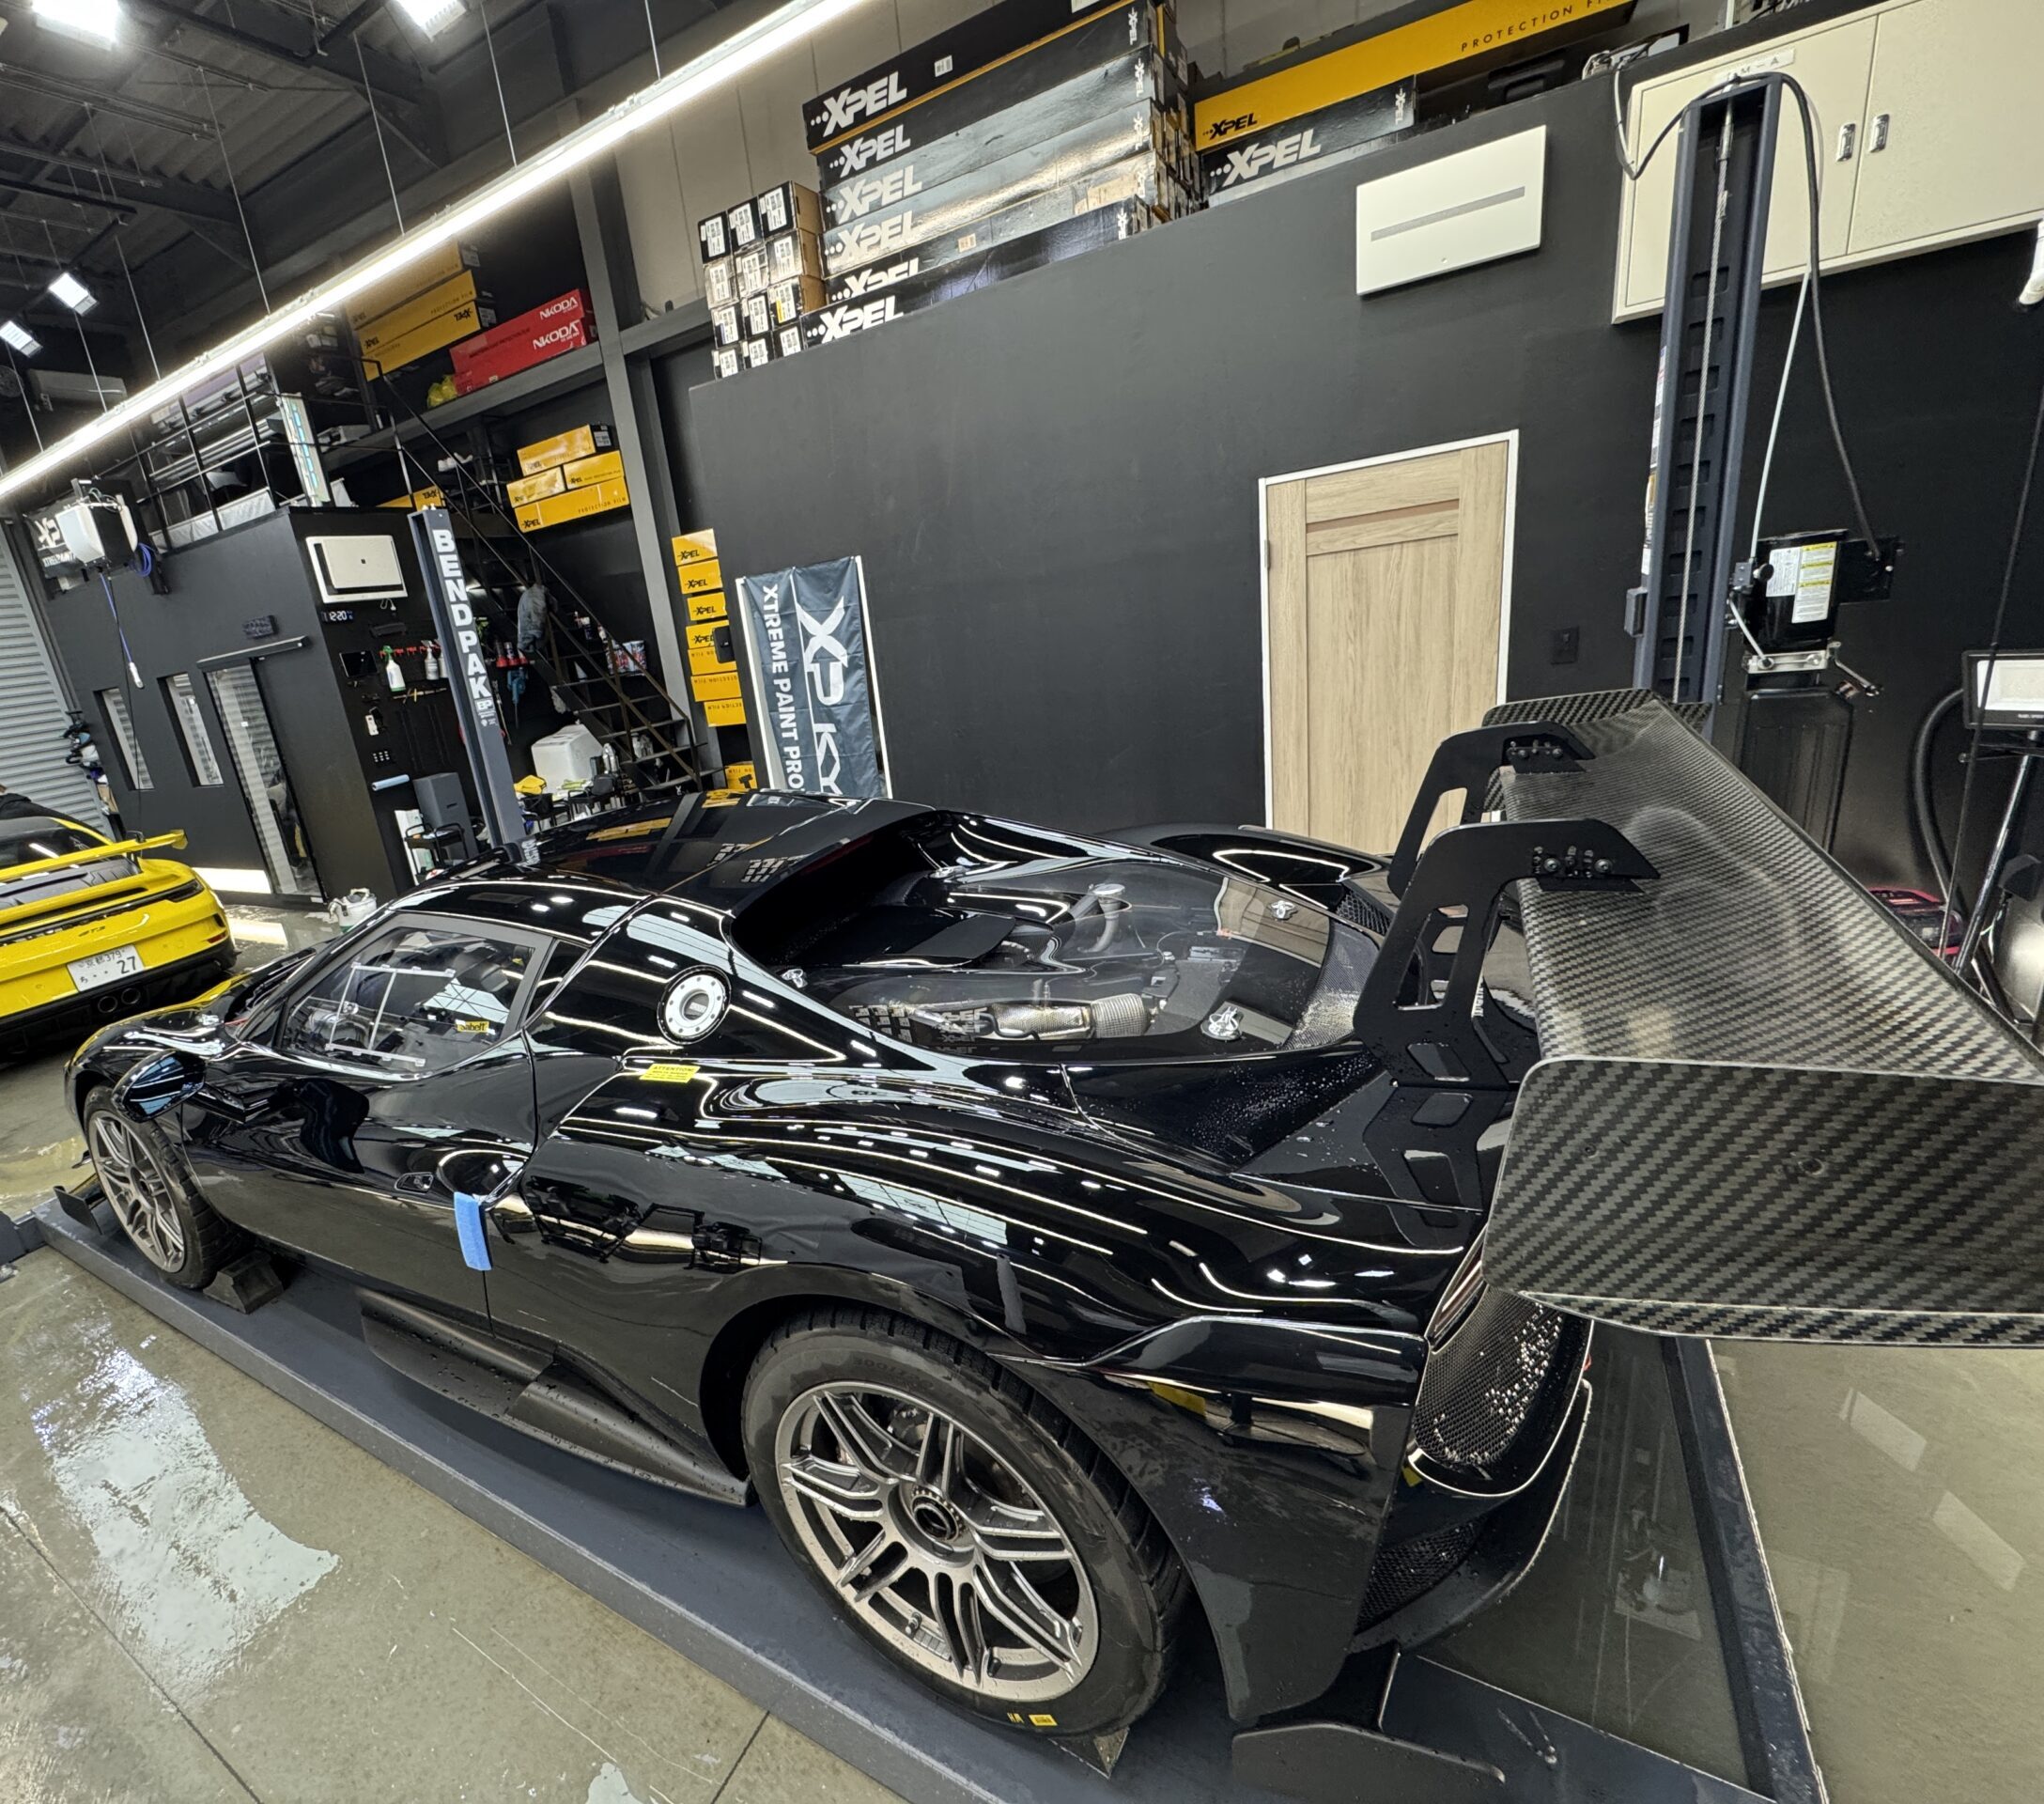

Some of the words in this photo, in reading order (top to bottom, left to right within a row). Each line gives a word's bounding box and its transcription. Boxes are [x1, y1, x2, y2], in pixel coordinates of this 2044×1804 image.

[1128, 10, 1138, 45] XPEL
[1462, 5, 1573, 52] PROTECTION
[1135, 62, 1144, 98] XPEL
[823, 70, 907, 138] XPEL
[1395, 92, 1406, 125] XPEL
[1210, 113, 1258, 140] XPEL
[840, 124, 911, 179] XPEL
[1222, 128, 1322, 188] XPEL
[839, 164, 922, 225] XPEL
[837, 210, 920, 261] XPEL
[539, 296, 579, 320] NKODA
[820, 295, 905, 344] XPEL
[533, 319, 581, 350] NKODA
[523, 518, 541, 529] XPEL
[680, 549, 700, 561] XPEL
[688, 579, 708, 589] XPEL
[432, 529, 492, 699] BENDPAK
[696, 605, 716, 616] XPEL
[763, 583, 789, 674] XTREME
[773, 677, 798, 741] PAINT
[782, 746, 806, 792] PRO
[116, 956, 136, 974] 27
